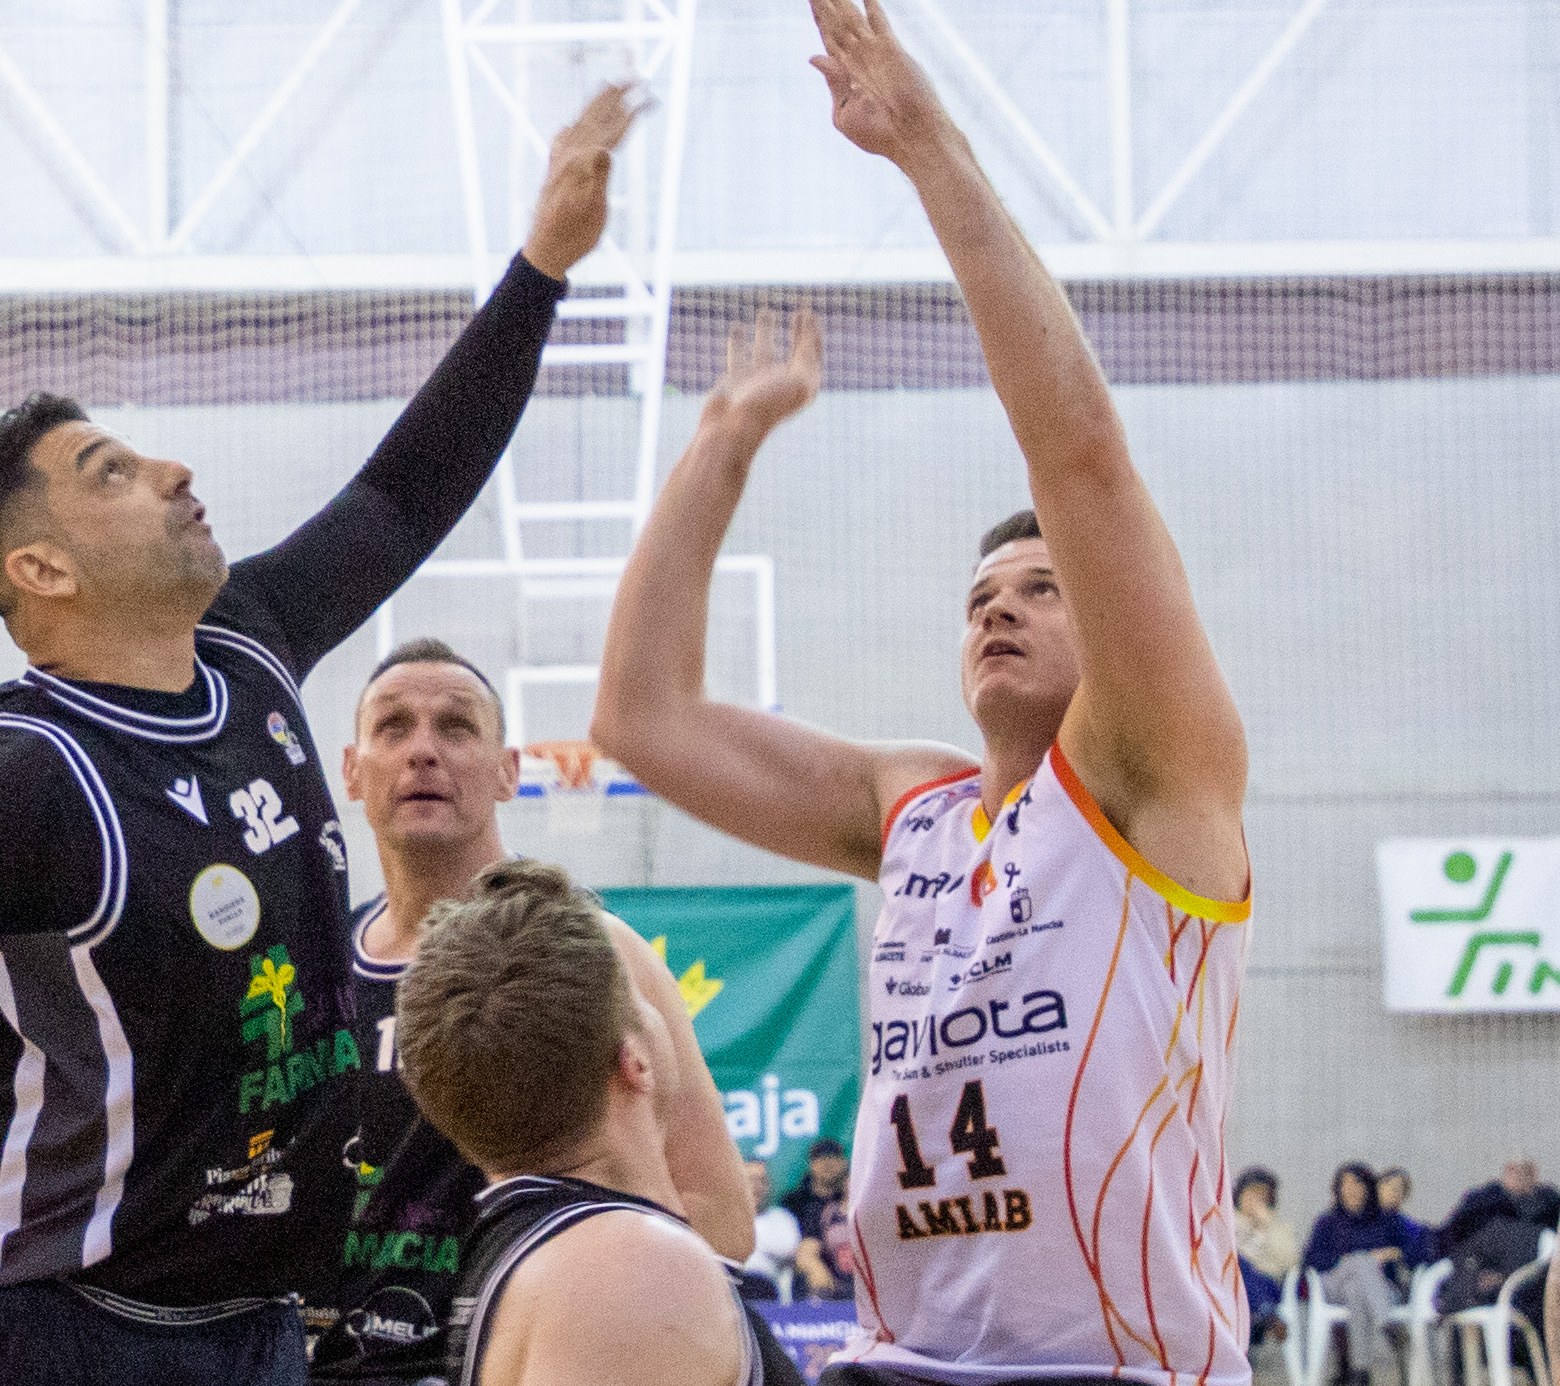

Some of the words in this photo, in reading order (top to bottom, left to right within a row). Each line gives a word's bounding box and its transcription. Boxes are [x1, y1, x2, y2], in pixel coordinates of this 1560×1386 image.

[230, 777, 301, 855] 32
[970, 951, 1013, 978] CLM
[375, 1015, 405, 1073] 1
[988, 1039, 1072, 1065] Specialists
[724, 1074, 821, 1158] aja
[890, 1079, 1008, 1190] 14
[895, 1188, 1034, 1241] AMIAB
